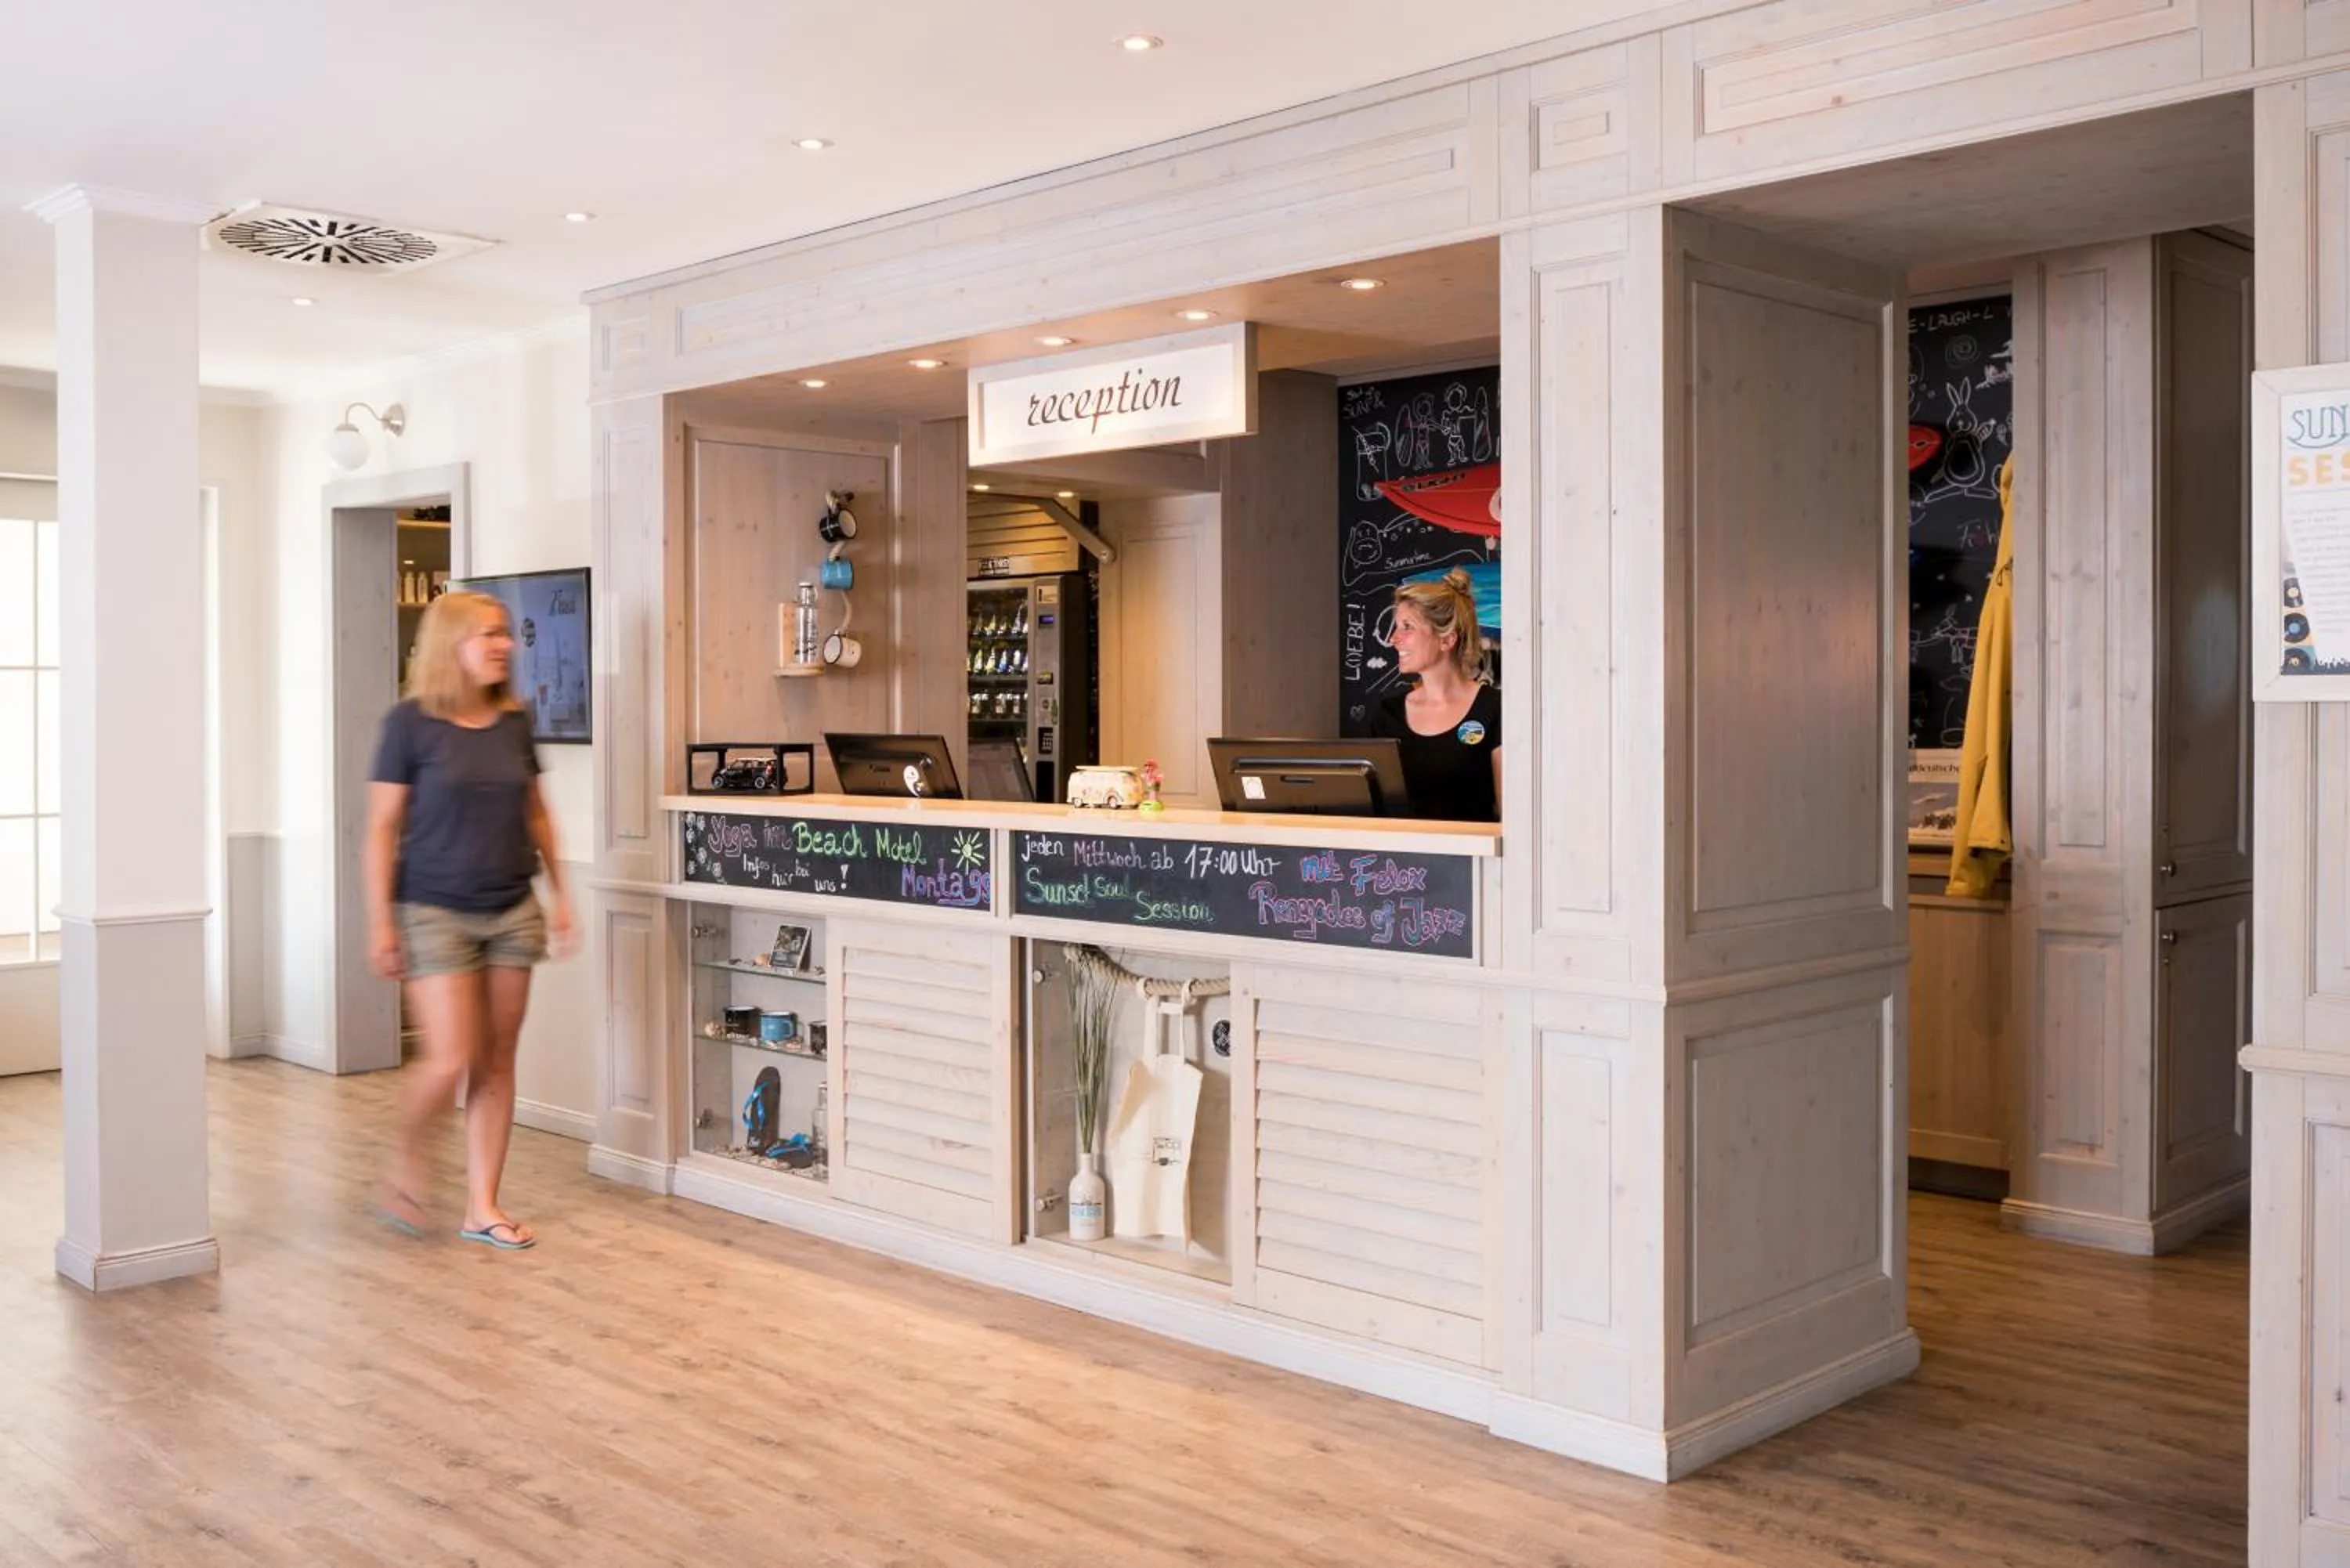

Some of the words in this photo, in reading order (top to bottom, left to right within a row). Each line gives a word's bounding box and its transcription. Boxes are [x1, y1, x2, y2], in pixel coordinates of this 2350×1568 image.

[1027, 368, 1182, 434] reception
[707, 815, 758, 858] Yoga
[792, 822, 868, 858] Beach
[875, 827, 927, 865] Motel
[1021, 834, 1065, 862] jeden
[1073, 840, 1146, 869] Mittwoch
[1150, 844, 1175, 871] ab
[743, 853, 770, 880] Infos
[1025, 867, 1090, 903] Sunset
